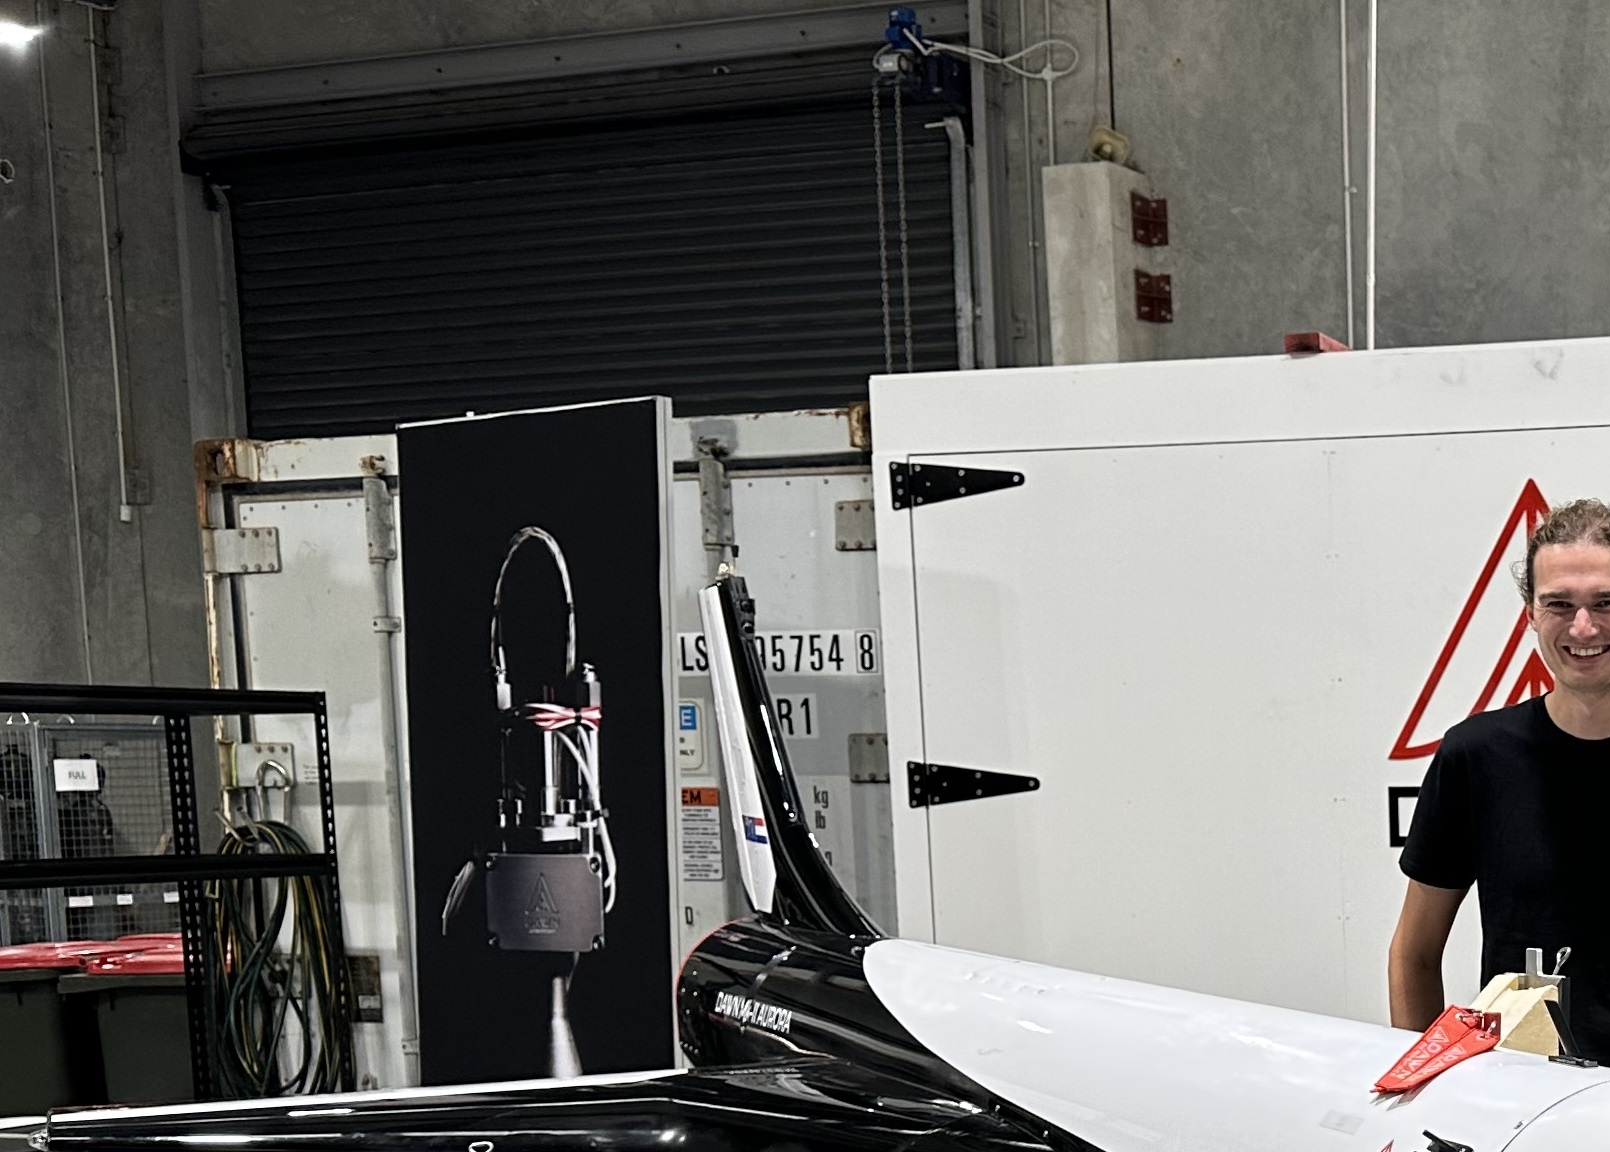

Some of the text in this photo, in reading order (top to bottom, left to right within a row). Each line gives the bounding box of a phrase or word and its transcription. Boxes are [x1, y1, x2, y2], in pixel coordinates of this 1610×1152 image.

[859, 634, 874, 671] 8
[777, 698, 811, 735] R1
[67, 770, 86, 780] FULL
[813, 785, 829, 809] kg
[815, 810, 826, 830] lb
[1397, 1042, 1441, 1079] DAWN
